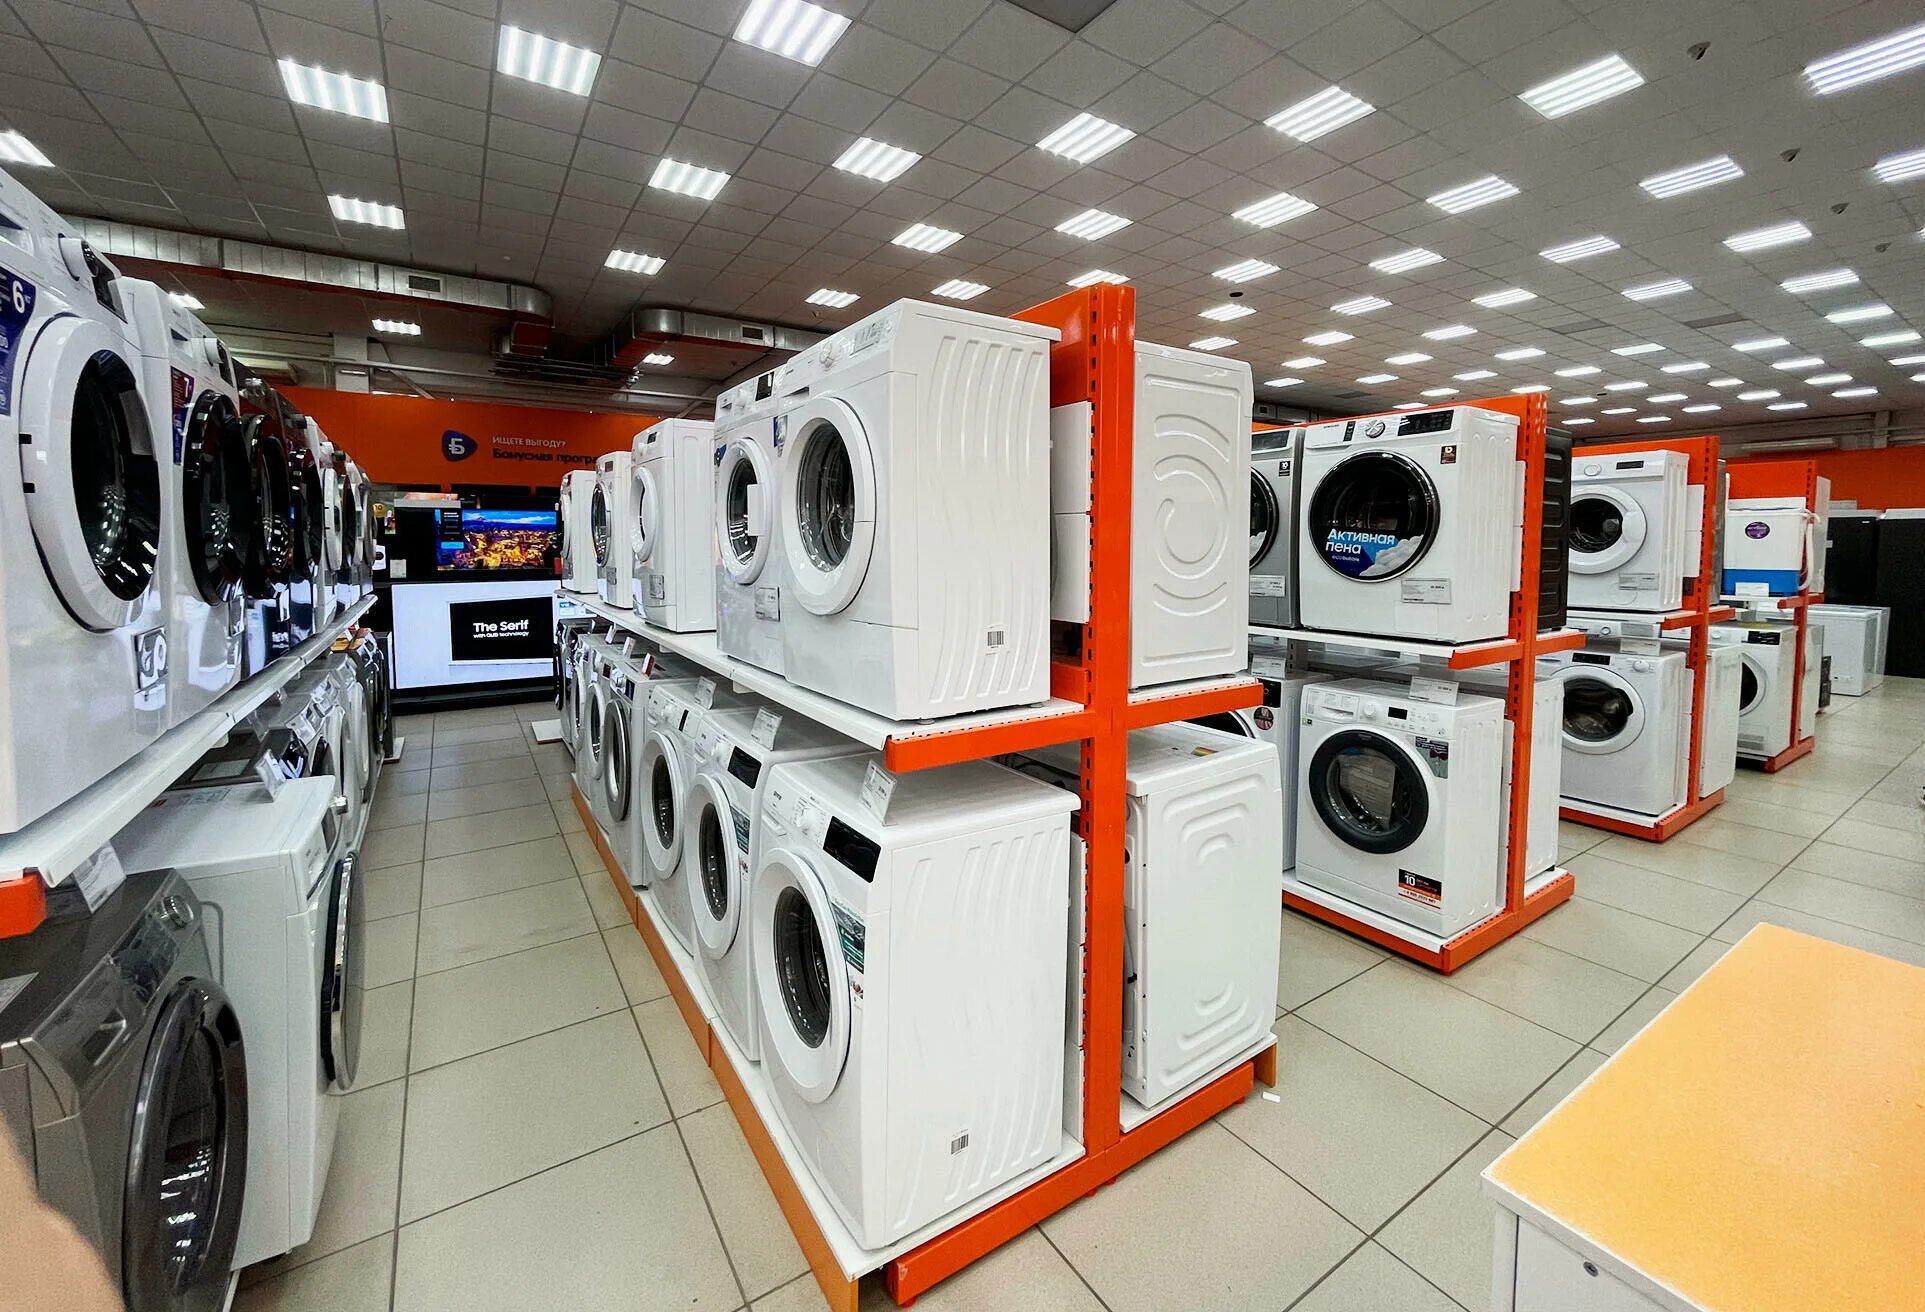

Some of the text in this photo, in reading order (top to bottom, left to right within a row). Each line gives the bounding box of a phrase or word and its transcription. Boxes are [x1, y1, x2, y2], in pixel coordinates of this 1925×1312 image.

[12, 280, 25, 314] 6
[492, 436, 566, 448] ИЩЕТЕ ВЫГОДУ?
[492, 448, 553, 462] Бонусная
[1327, 528, 1396, 545] Активная
[1325, 541, 1362, 555] пена
[473, 619, 529, 633] The Serif
[1404, 874, 1416, 887] 10
